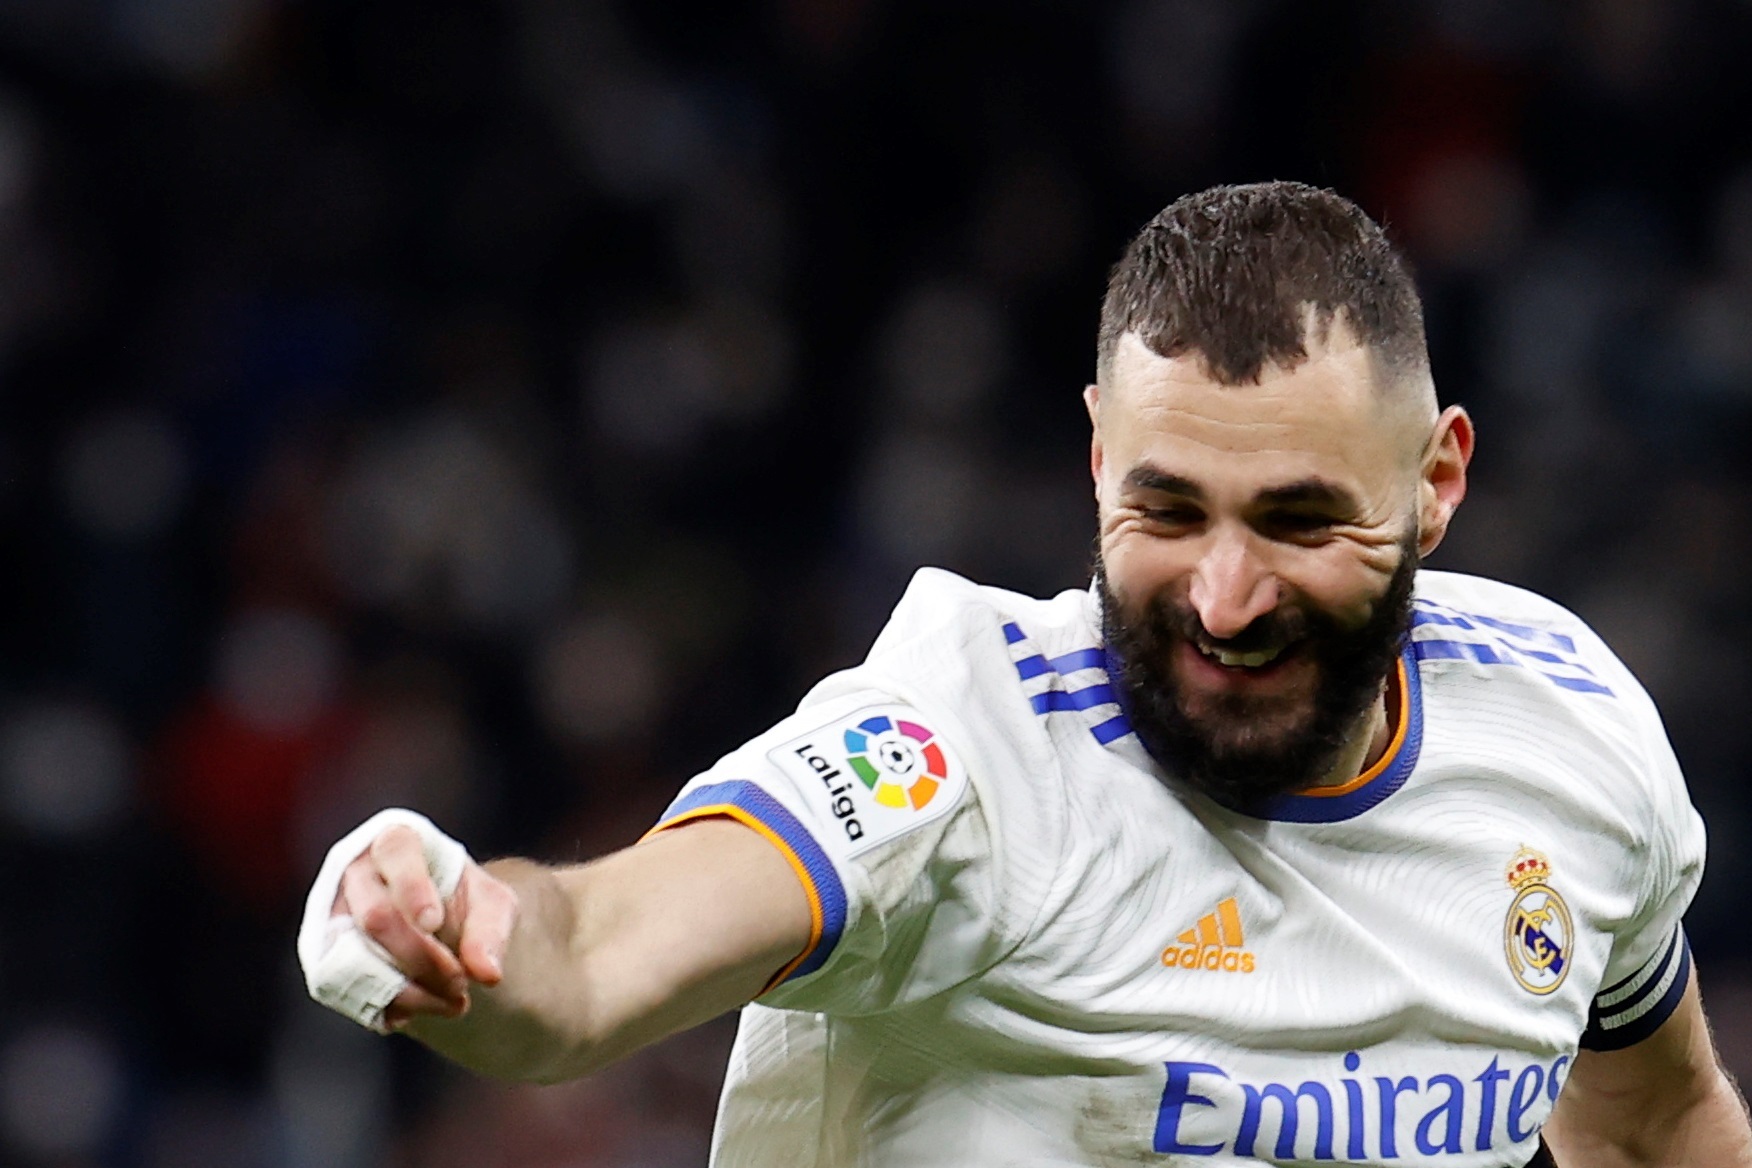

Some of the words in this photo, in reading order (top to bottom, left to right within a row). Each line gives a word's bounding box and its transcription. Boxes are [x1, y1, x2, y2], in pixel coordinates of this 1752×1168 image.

[795, 744, 864, 842] LaLiga
[1161, 944, 1256, 973] adidas
[1153, 1051, 1569, 1160] Emirates
